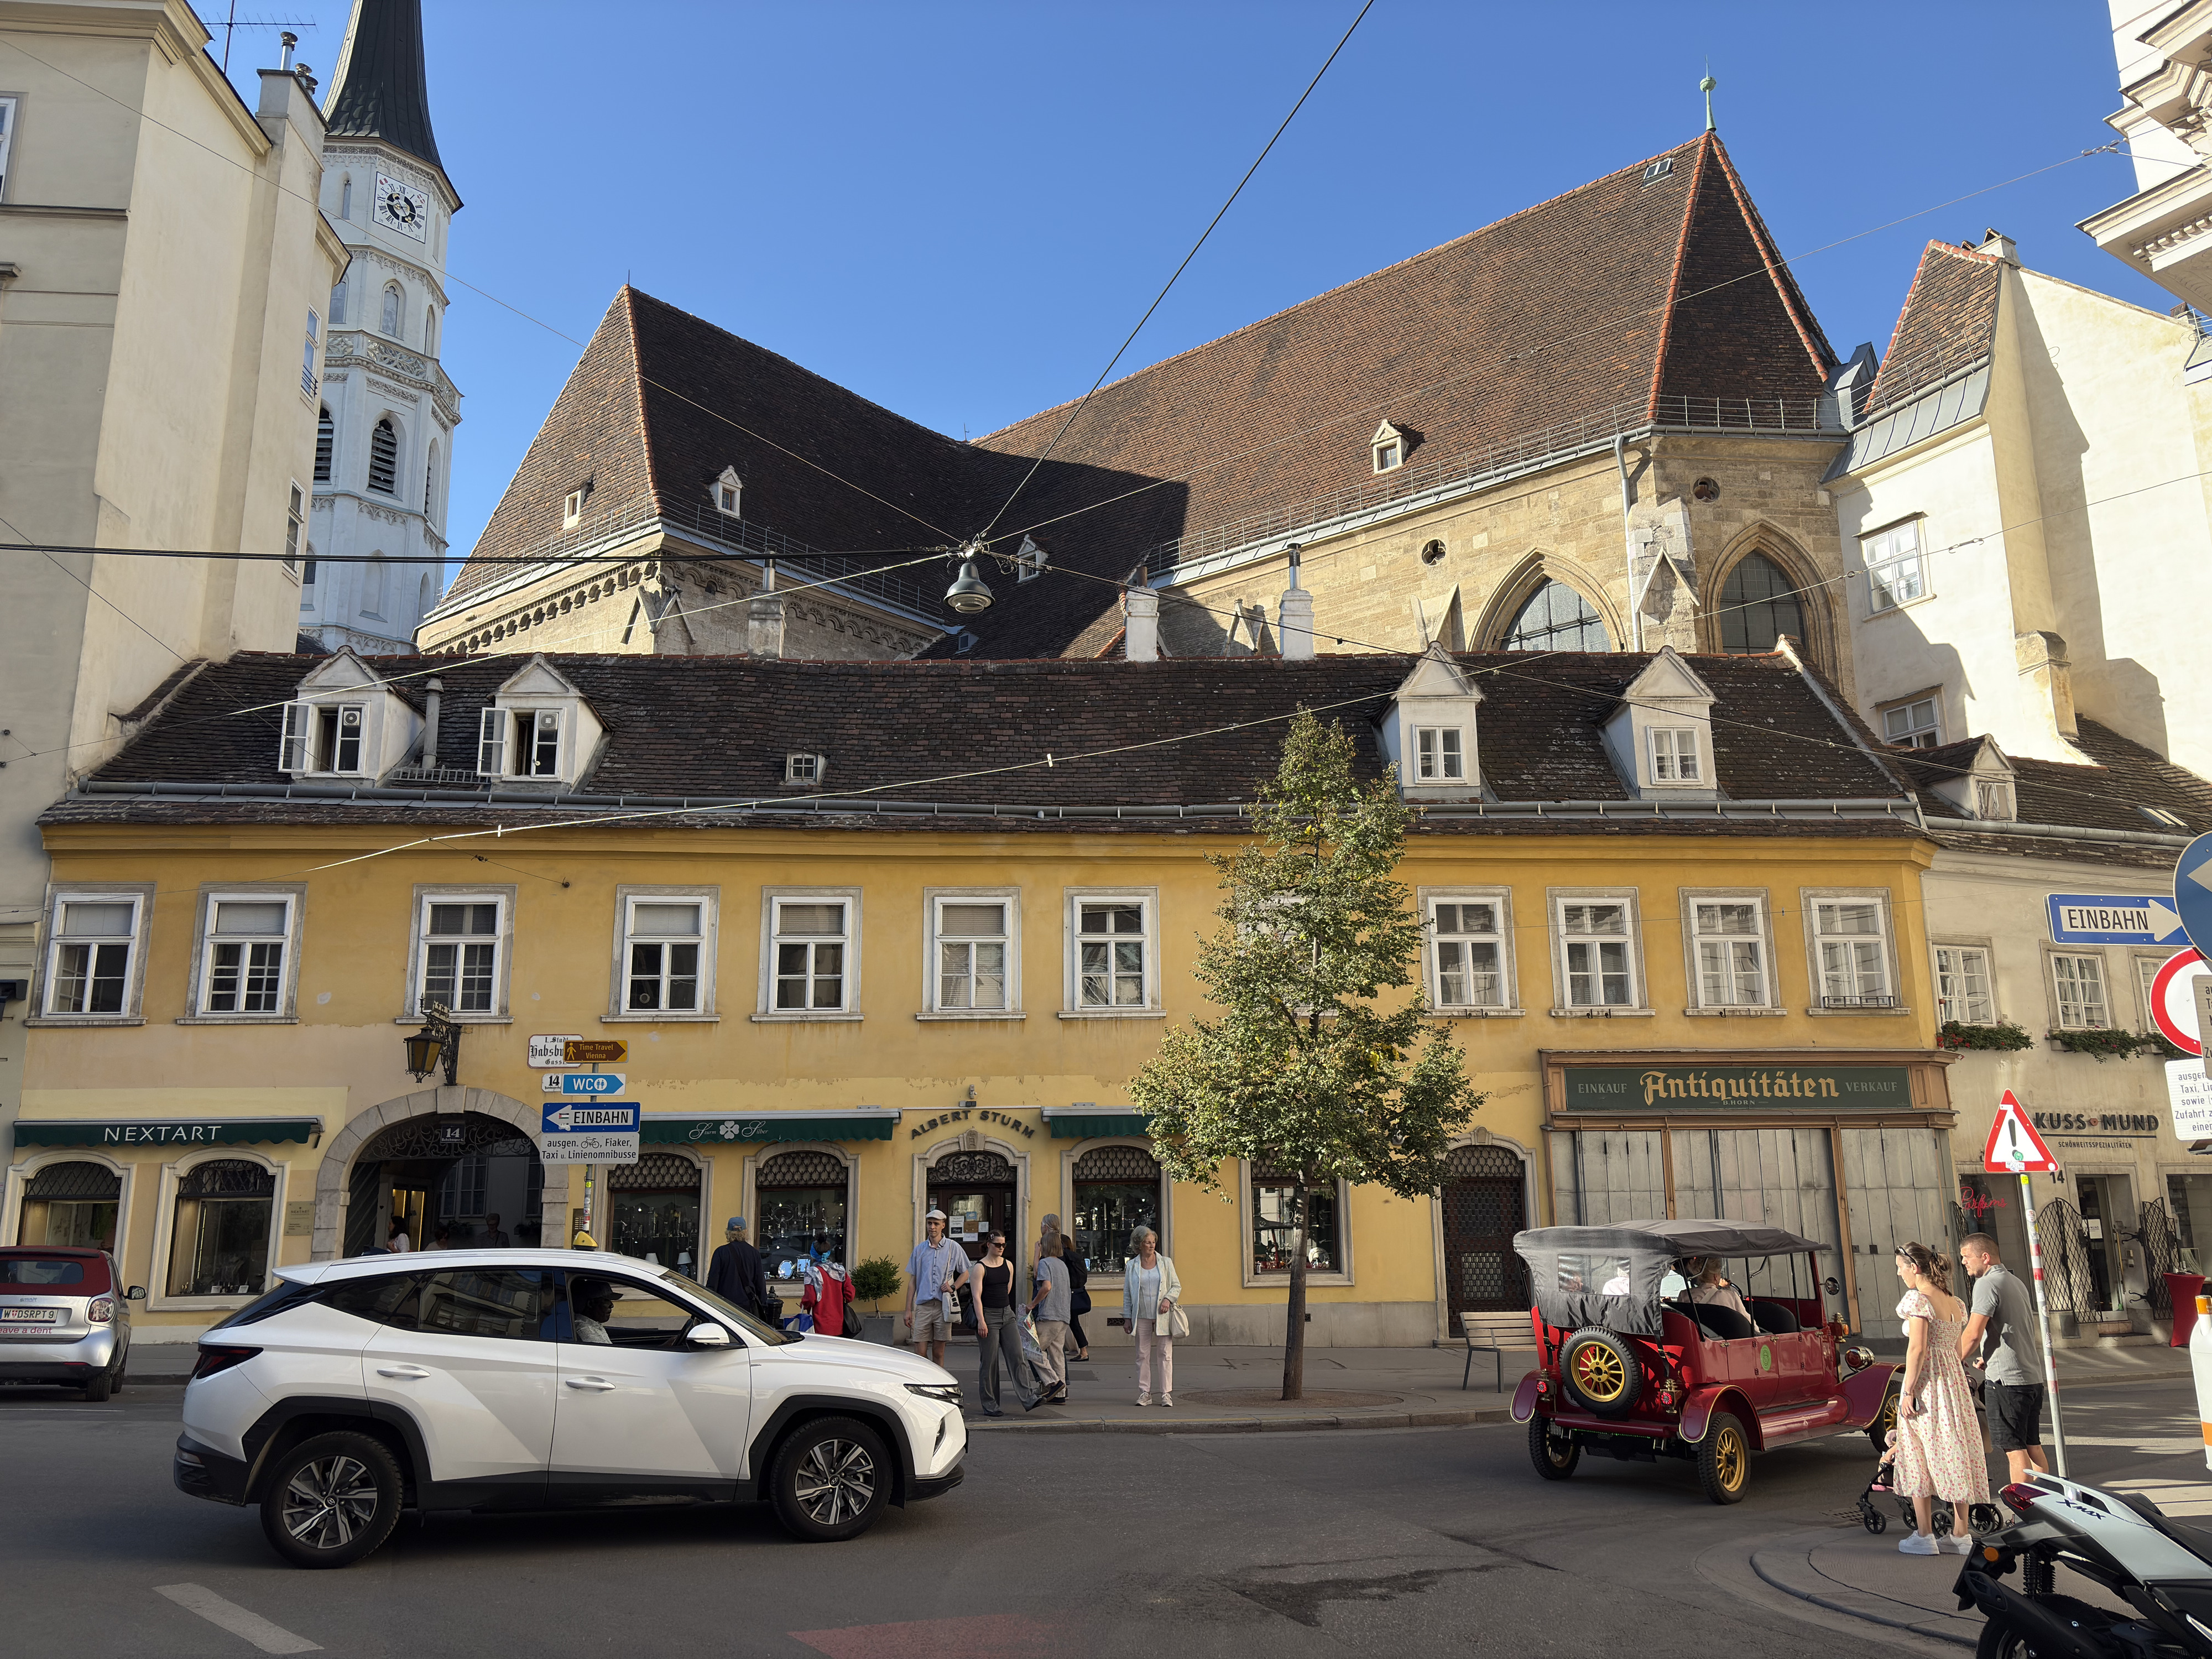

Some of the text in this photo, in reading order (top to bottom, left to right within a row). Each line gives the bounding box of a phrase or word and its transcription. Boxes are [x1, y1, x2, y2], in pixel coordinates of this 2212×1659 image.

[2067, 909, 2149, 930] EINBAHN
[549, 1075, 560, 1086] 14
[573, 1078, 593, 1091] WC
[1578, 1071, 1897, 1106] EINKAUF Antiquitäten VERKAUF
[2180, 1083, 2199, 1094] Taxi,
[2181, 1095, 2205, 1105] sowie
[573, 1111, 629, 1124] EINBAHN
[2174, 1109, 2205, 1119] Zufahrt
[911, 1109, 1035, 1140] ALBERT STURM
[2035, 1112, 2159, 1131] KUSS MUND
[104, 1126, 222, 1141] NEXTART
[446, 1128, 460, 1138] 14
[742, 1120, 769, 1138] Silber
[547, 1138, 632, 1149] ausgen. Fiaker,
[2058, 1140, 2132, 1149] SCHÖNHEITSSPEZIALITÄTEN
[542, 1150, 559, 1159] Taxi
[568, 1150, 637, 1159] Linienomnibusse
[2049, 1169, 2065, 1184] 14
